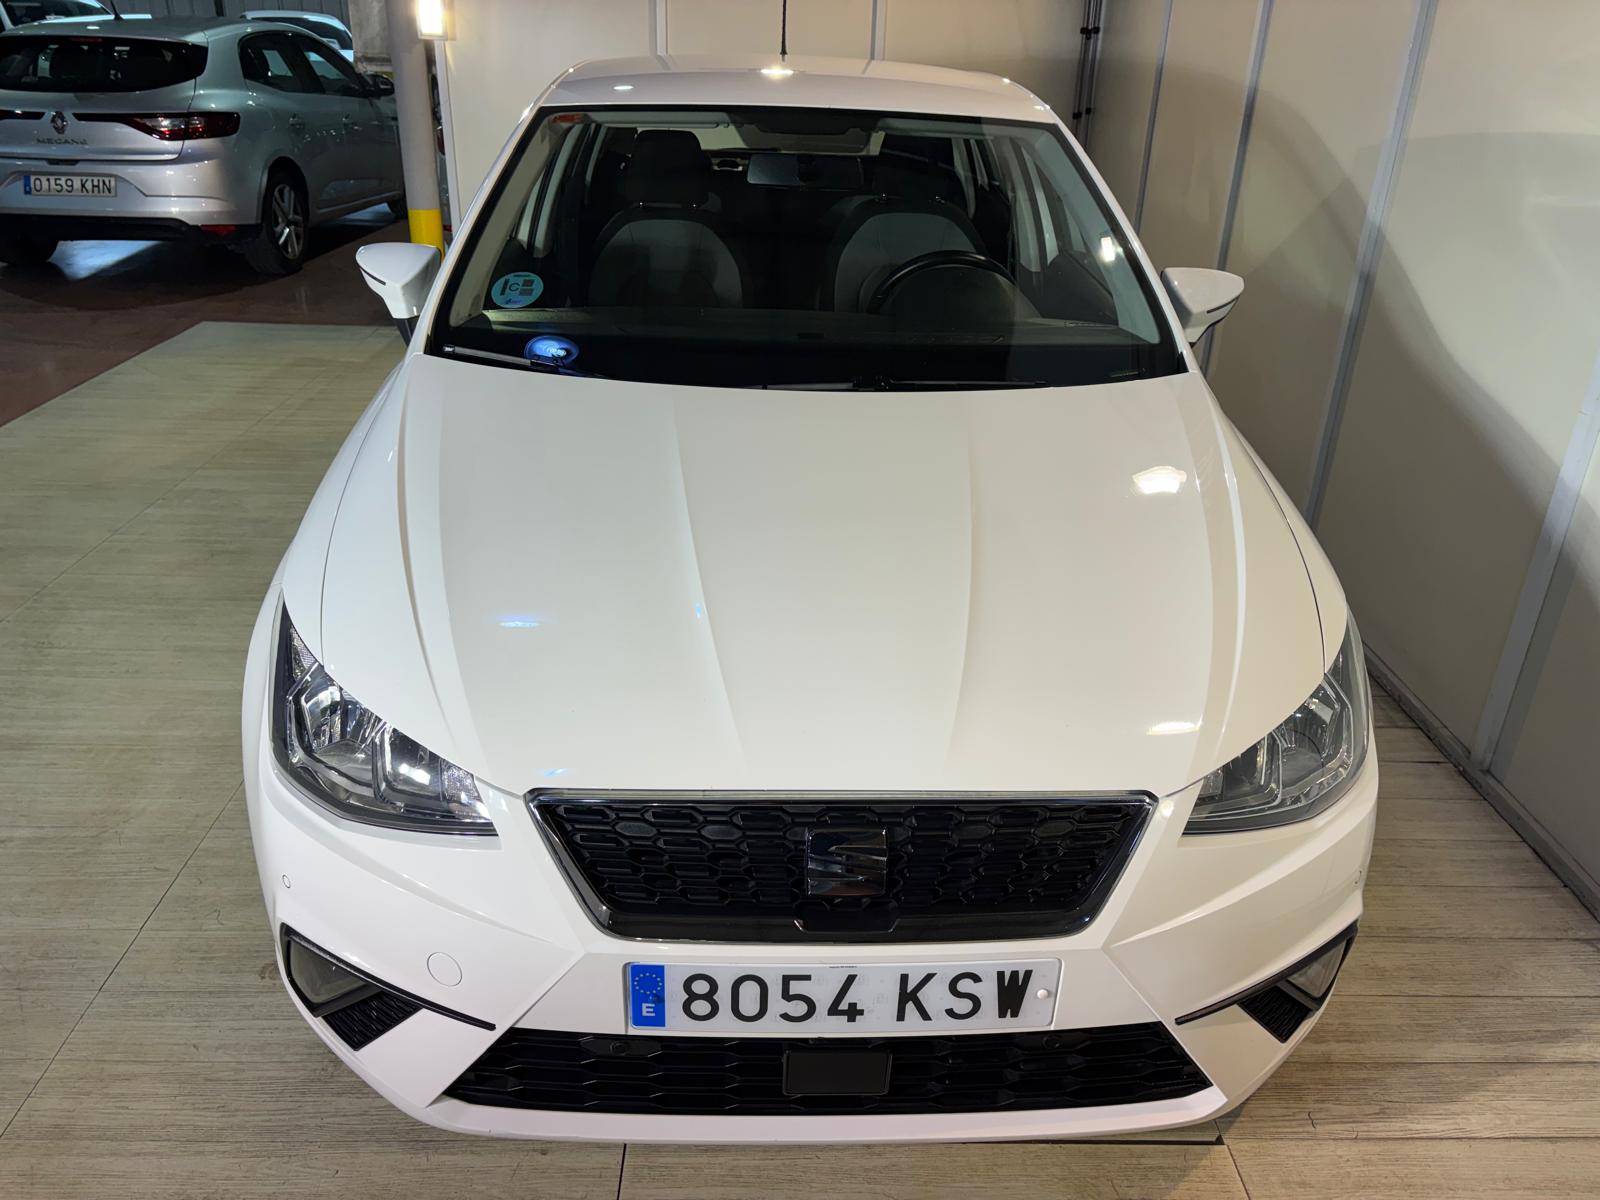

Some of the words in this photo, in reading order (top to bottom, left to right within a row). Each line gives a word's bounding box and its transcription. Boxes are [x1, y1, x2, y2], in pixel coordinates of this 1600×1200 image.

[33, 177, 74, 193] 0159
[80, 178, 112, 194] KHN
[641, 1003, 656, 1017] E
[681, 972, 865, 1023] 8054
[895, 969, 1034, 1022] KSW
